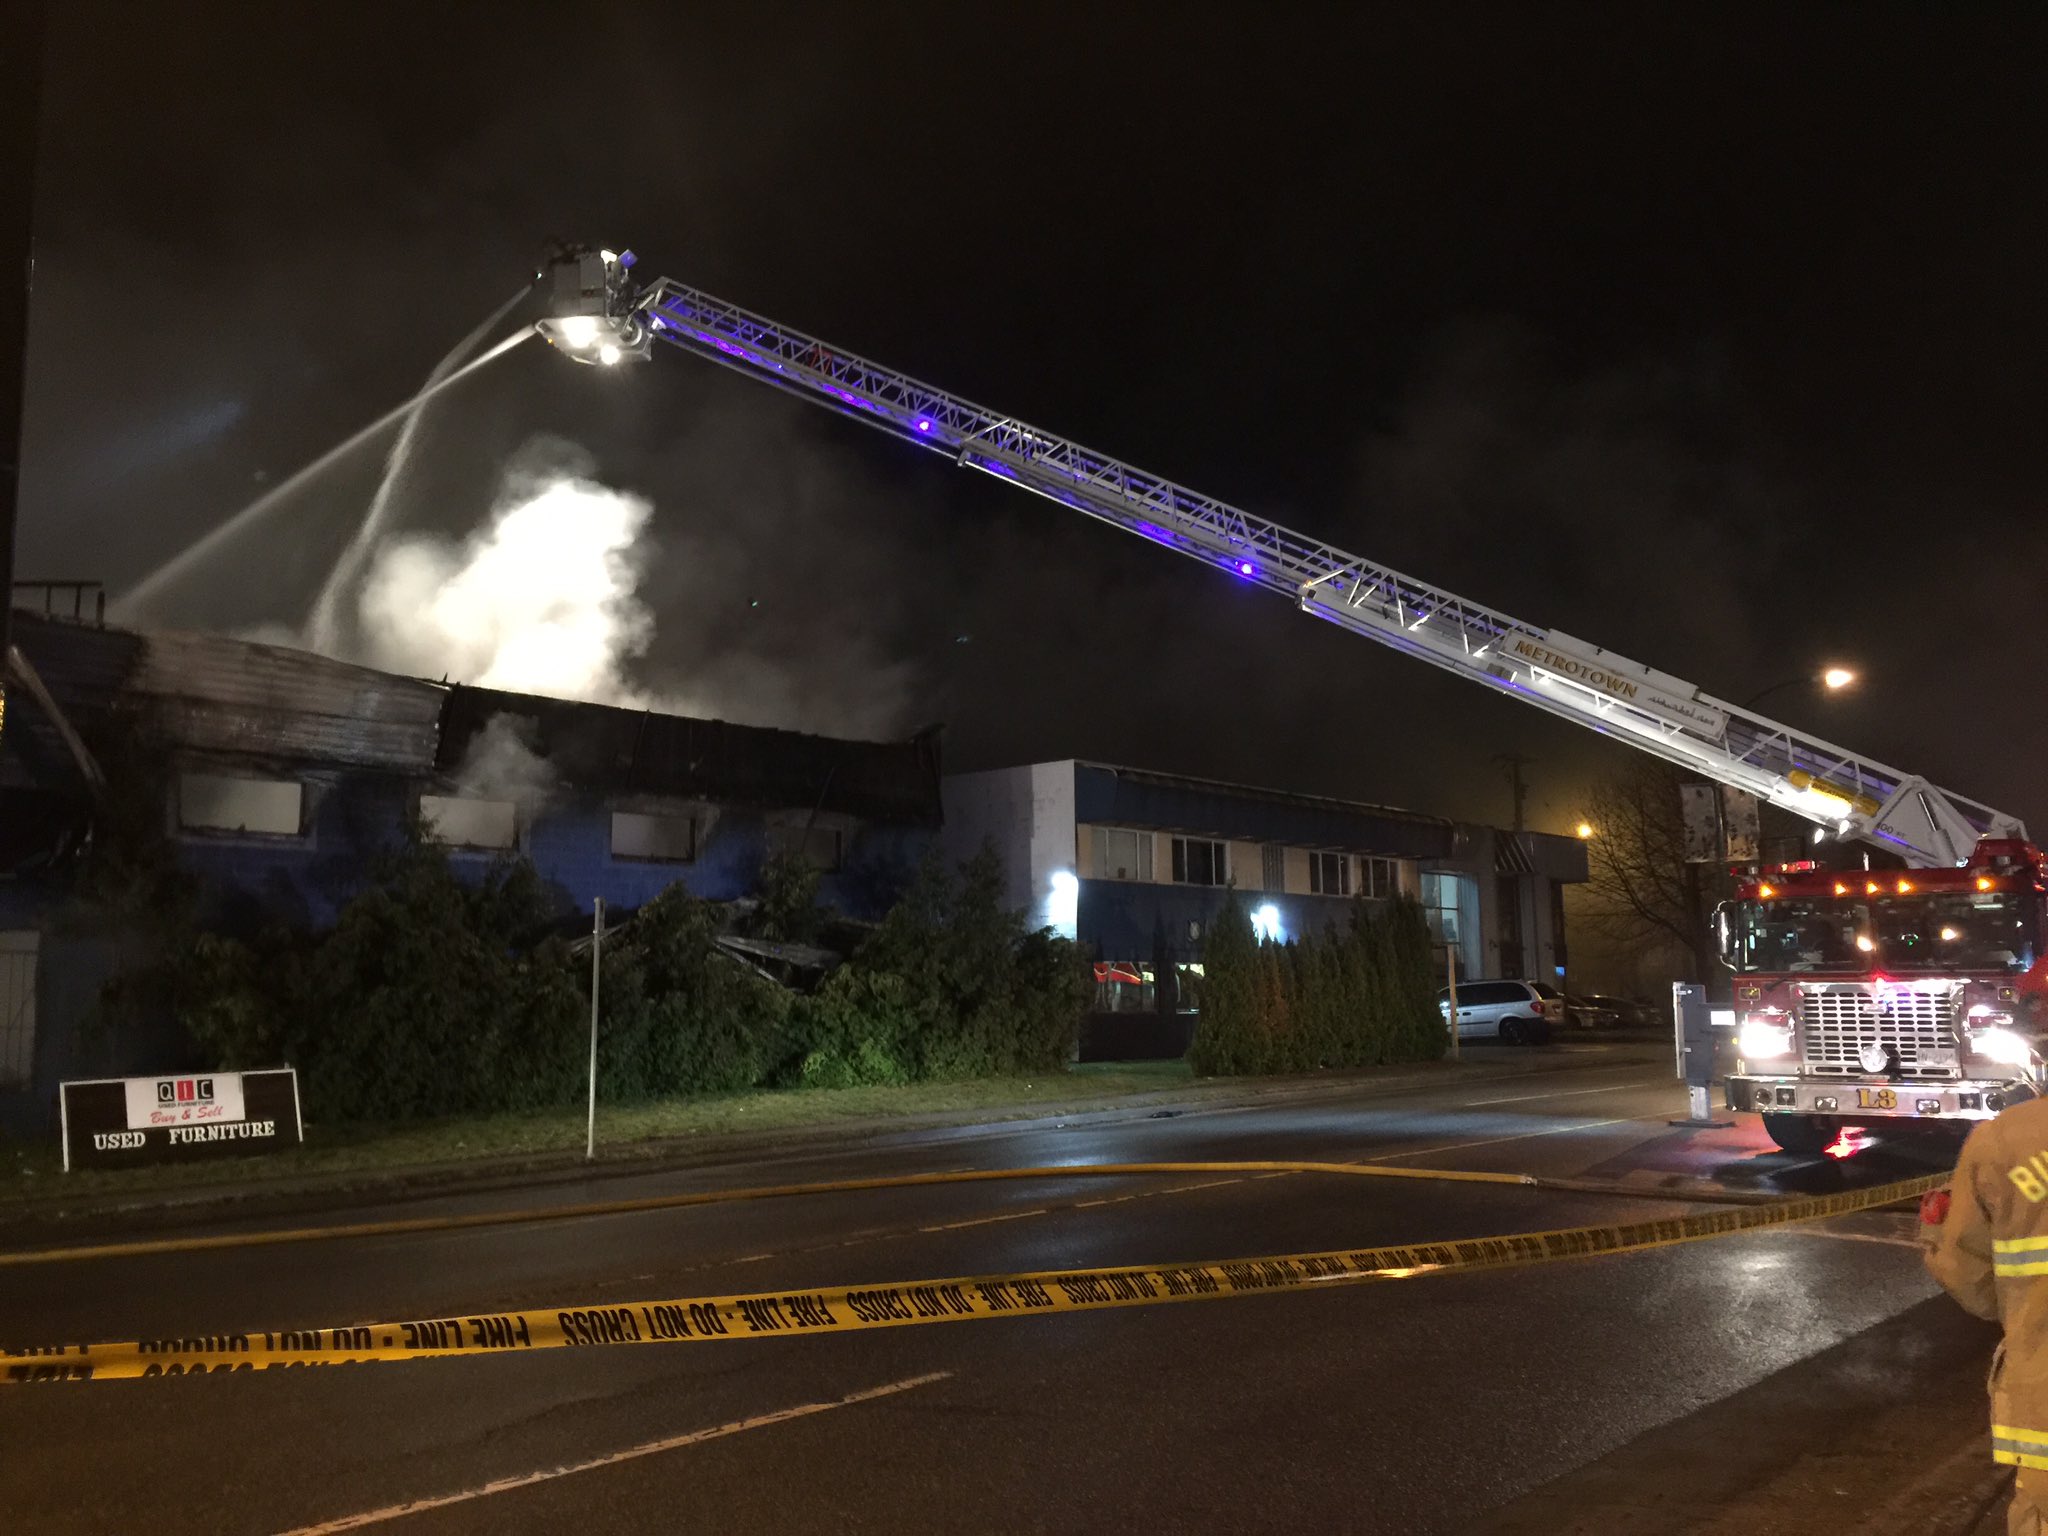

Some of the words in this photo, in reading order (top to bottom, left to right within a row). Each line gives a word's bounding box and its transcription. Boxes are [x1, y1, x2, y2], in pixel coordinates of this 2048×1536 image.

[1514, 640, 1638, 698] METROTOWN
[158, 1080, 213, 1101] QIC
[1856, 1088, 1898, 1109] L3
[150, 1111, 176, 1124] Buy
[182, 1109, 191, 1120] &
[198, 1105, 223, 1118] Sell
[94, 1131, 146, 1150] USED
[169, 1120, 275, 1145] FURNITURE
[846, 1289, 912, 1322] CROSS
[907, 1286, 949, 1316] NOT
[940, 1285, 974, 1314] DO
[975, 1282, 1020, 1310] LINE
[1009, 1279, 1054, 1307] FIRE
[642, 1305, 694, 1339] NOT
[690, 1302, 728, 1336] DO
[736, 1298, 791, 1331] LINE
[783, 1295, 838, 1326] FIRE
[558, 1308, 641, 1345] CROSS
